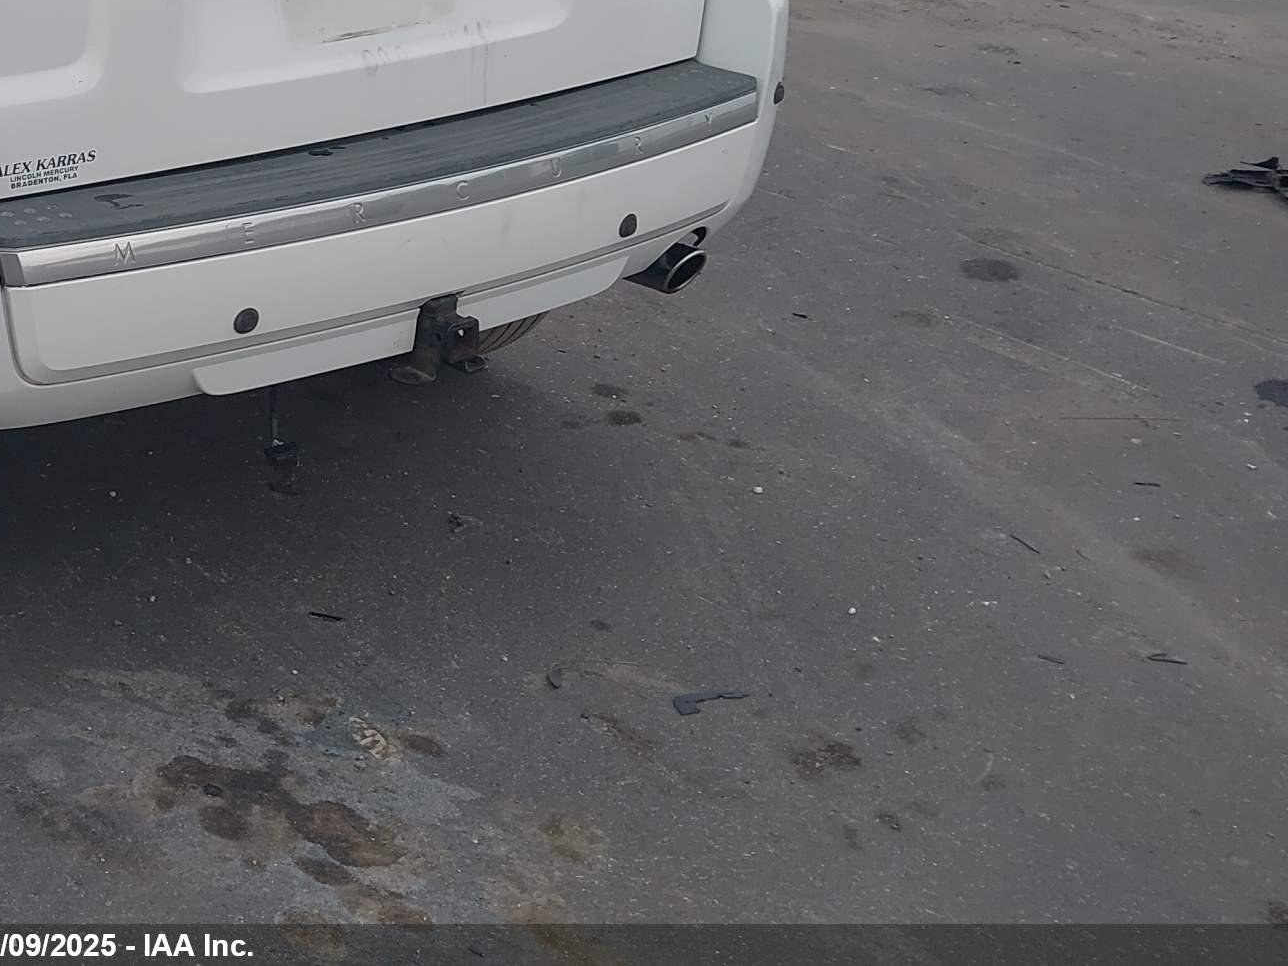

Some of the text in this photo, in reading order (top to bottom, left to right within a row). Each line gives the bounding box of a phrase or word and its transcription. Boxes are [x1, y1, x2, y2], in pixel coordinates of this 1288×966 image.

[36, 150, 96, 170] KARRAS
[9, 165, 79, 183] LINCOLN MERCURY
[10, 172, 78, 189] BRADENTON, FLA
